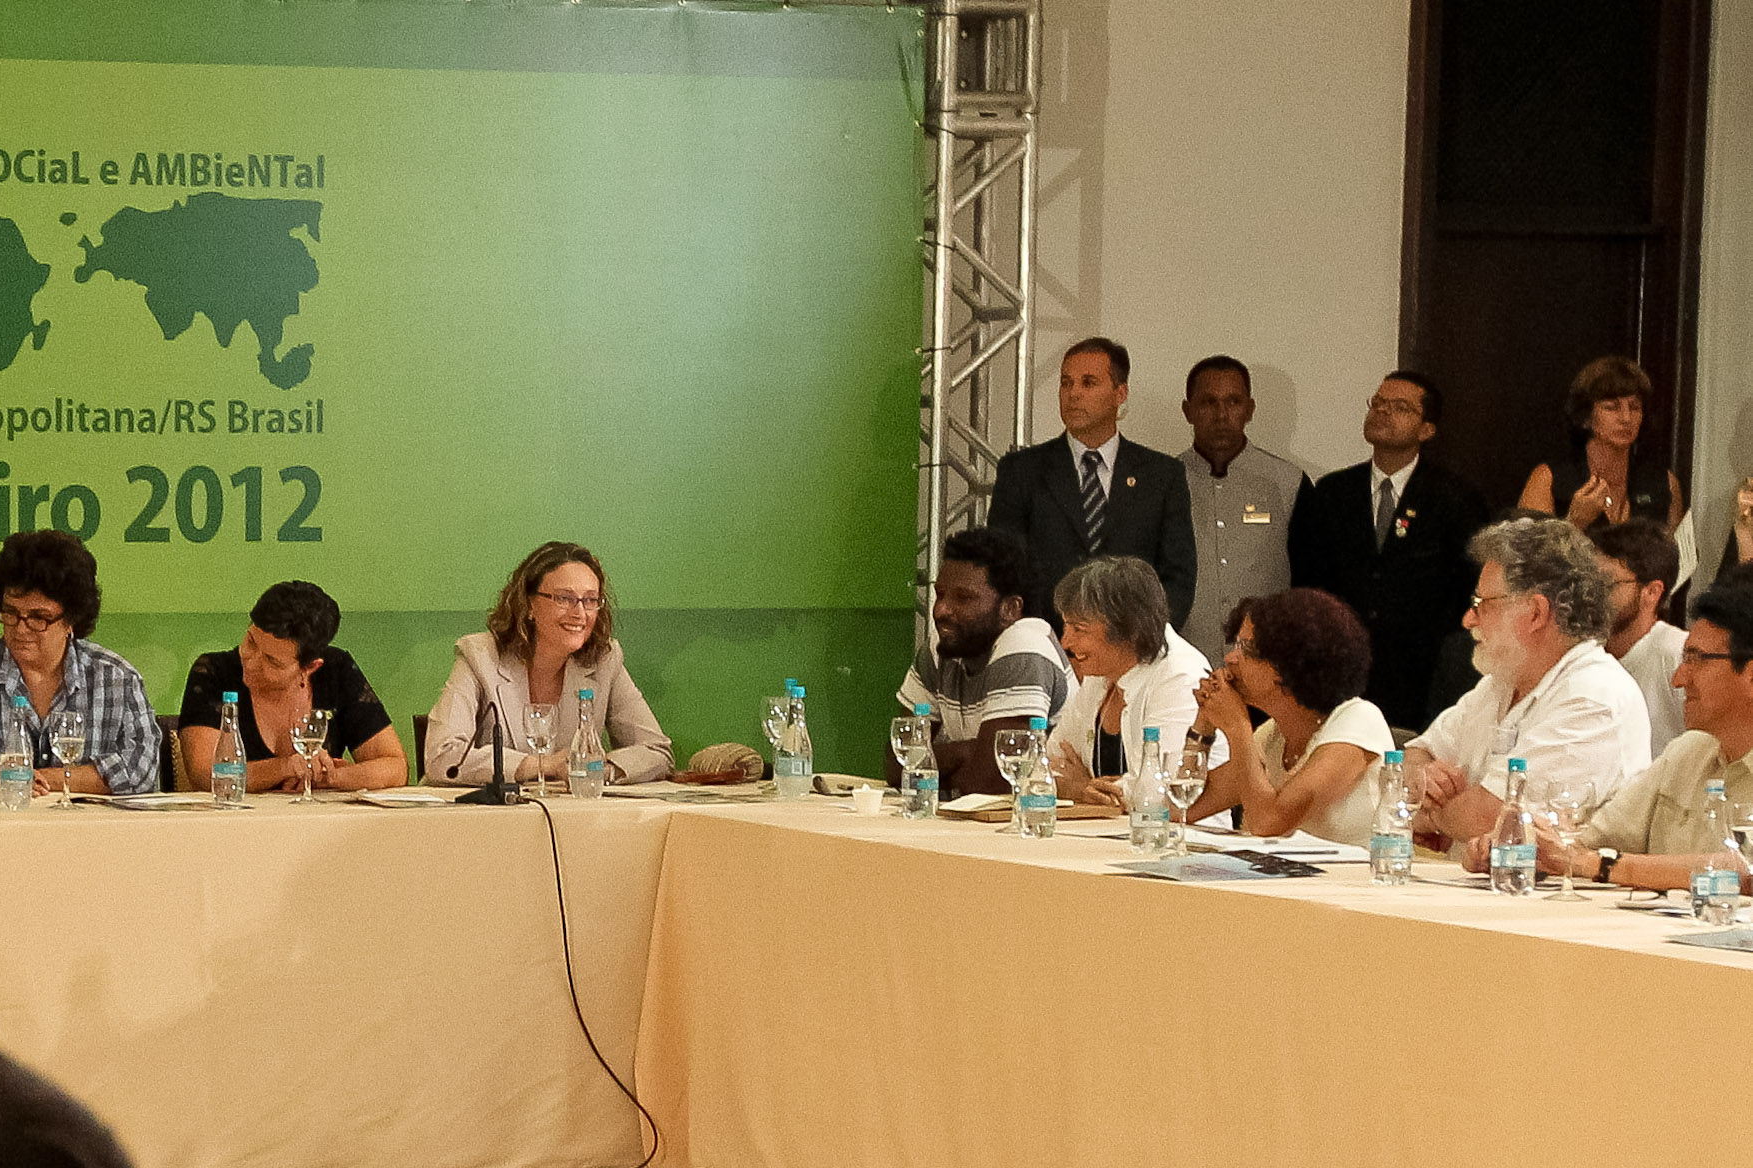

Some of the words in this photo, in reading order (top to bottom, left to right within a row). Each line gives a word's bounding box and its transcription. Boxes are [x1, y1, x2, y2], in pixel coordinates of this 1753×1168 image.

[99, 159, 120, 186] e
[129, 152, 325, 189] AMBieNTal
[228, 399, 324, 434] Brasil
[123, 464, 324, 544] 2012
